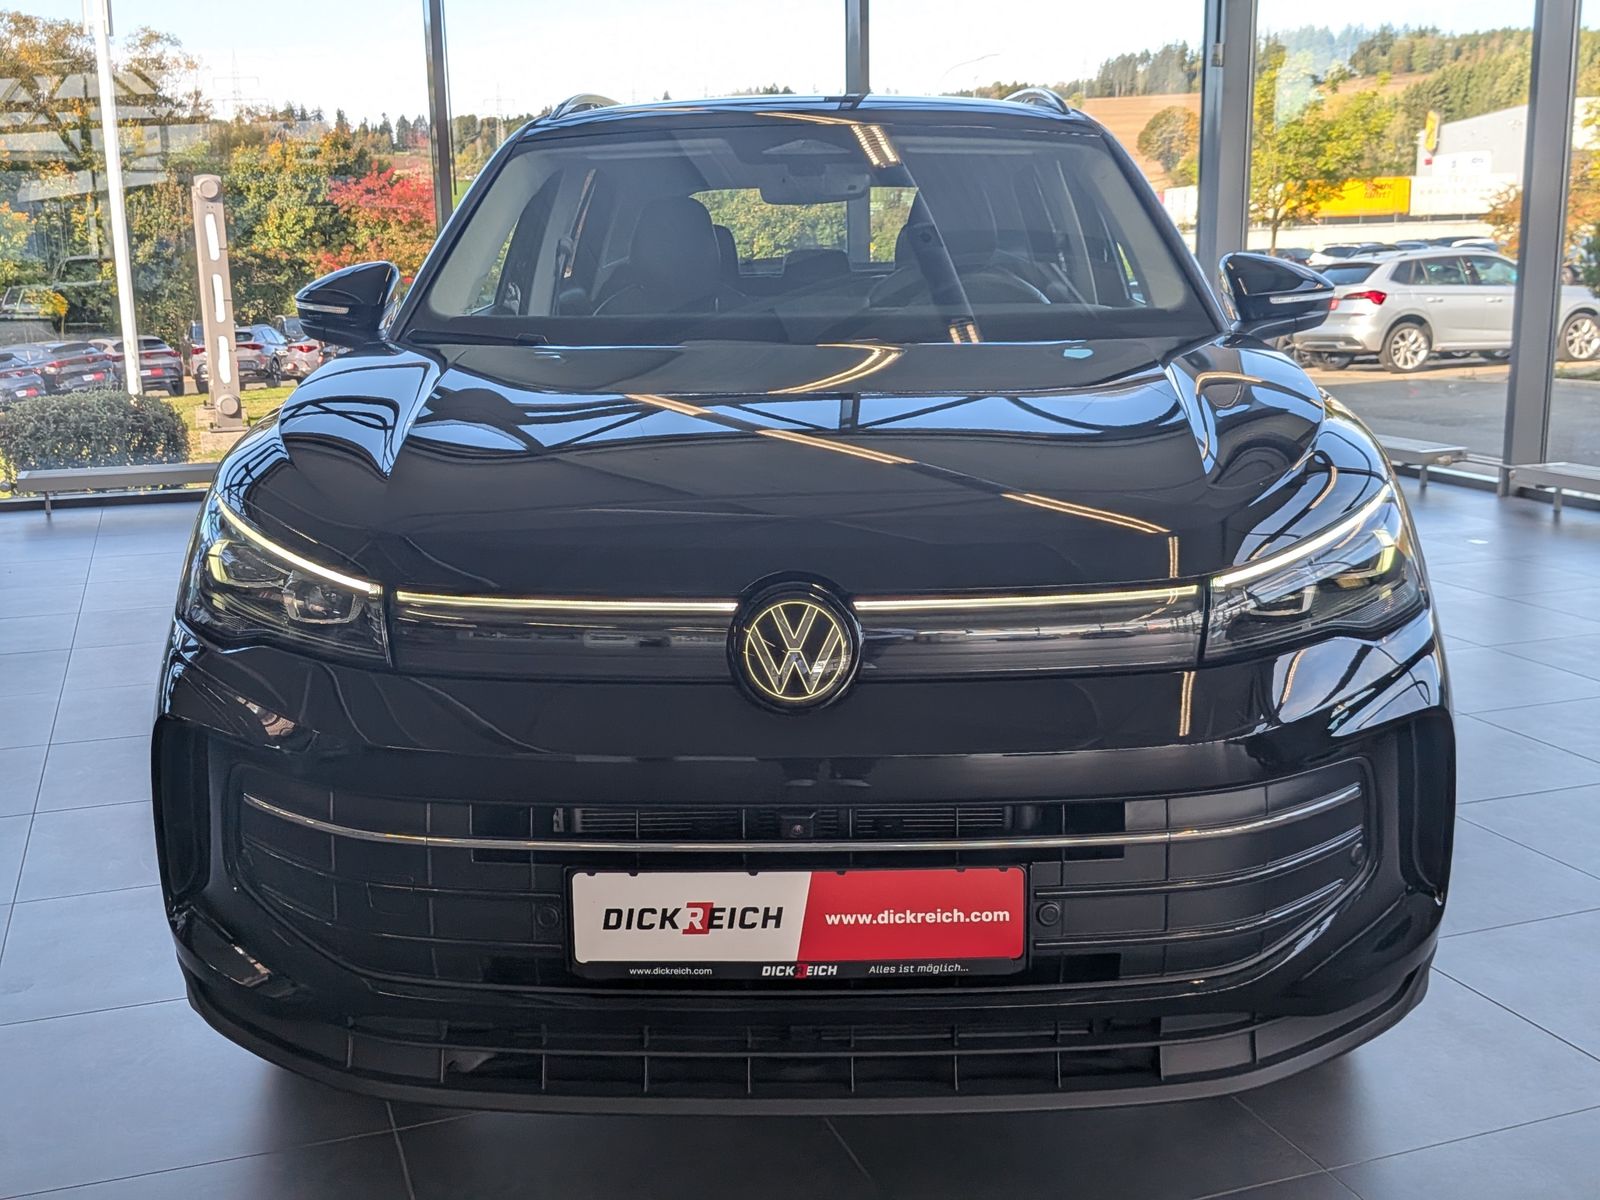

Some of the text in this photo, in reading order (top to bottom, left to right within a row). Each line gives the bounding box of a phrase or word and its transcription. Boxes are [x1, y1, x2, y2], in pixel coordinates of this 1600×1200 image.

[745, 601, 844, 700] VW
[602, 902, 783, 934] DICKREICH
[825, 908, 1010, 925] www.dickreich.com
[629, 967, 712, 975] www.dickreich.com
[868, 965, 896, 974] Alles
[898, 964, 915, 973] ist
